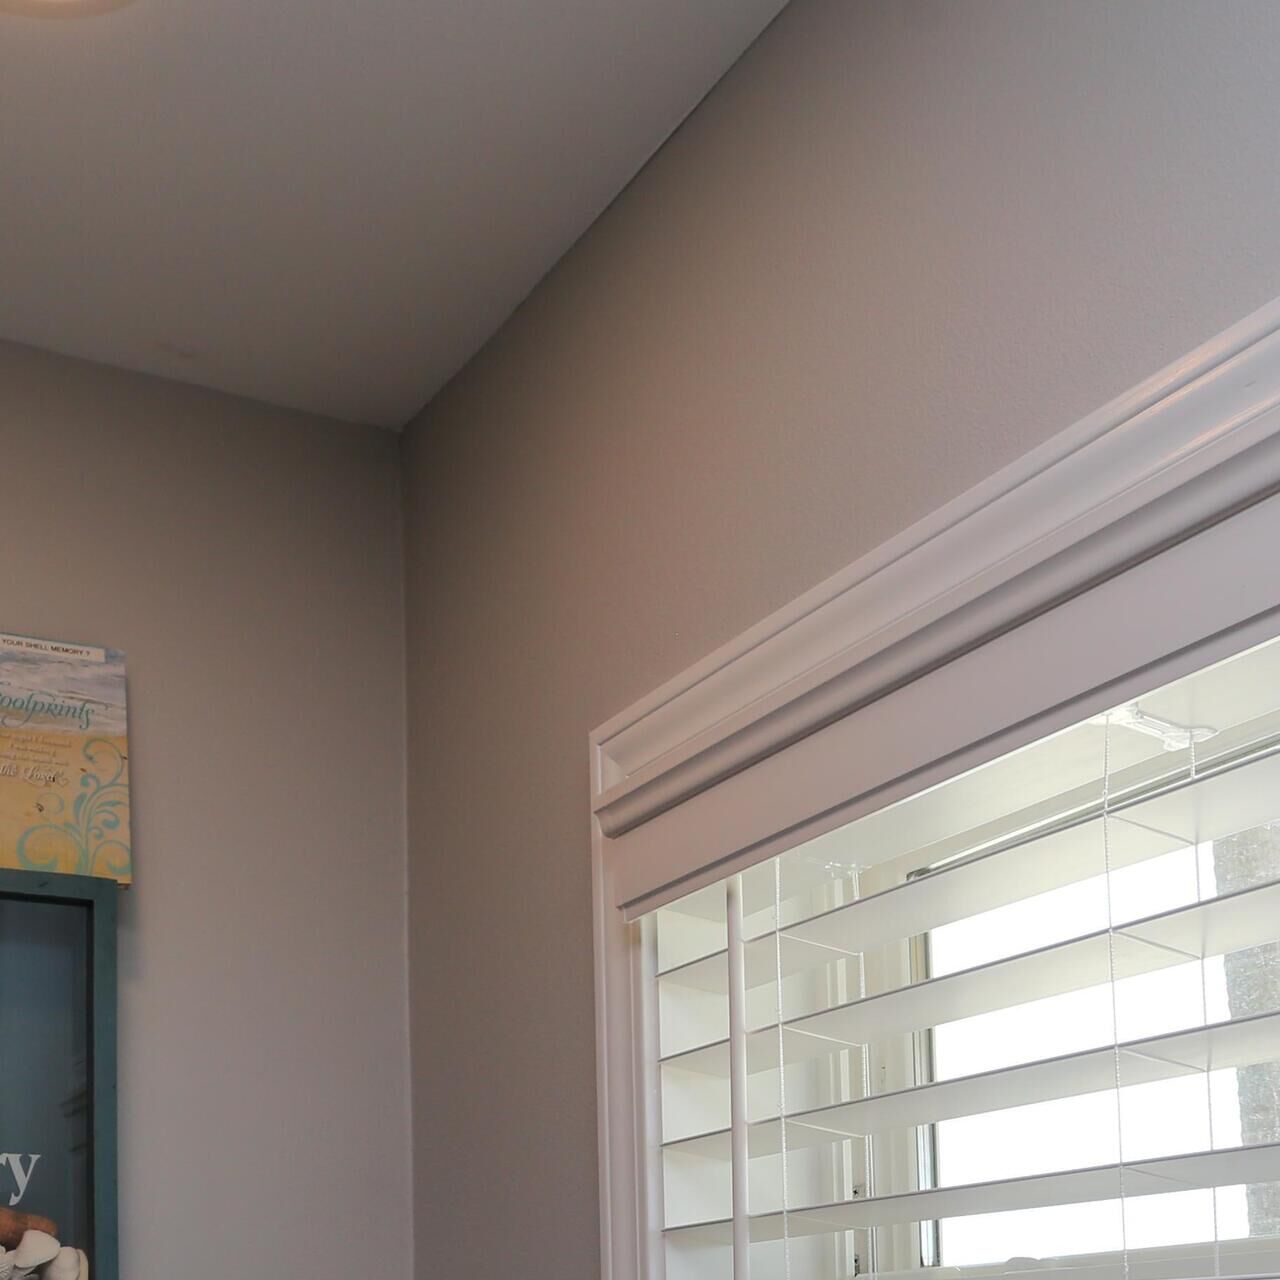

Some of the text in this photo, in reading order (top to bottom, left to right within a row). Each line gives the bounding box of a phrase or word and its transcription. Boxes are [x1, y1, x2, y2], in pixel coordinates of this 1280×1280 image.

[2, 639, 23, 648] YOUR
[25, 642, 48, 651] SHELL
[50, 645, 83, 656] MEMORY
